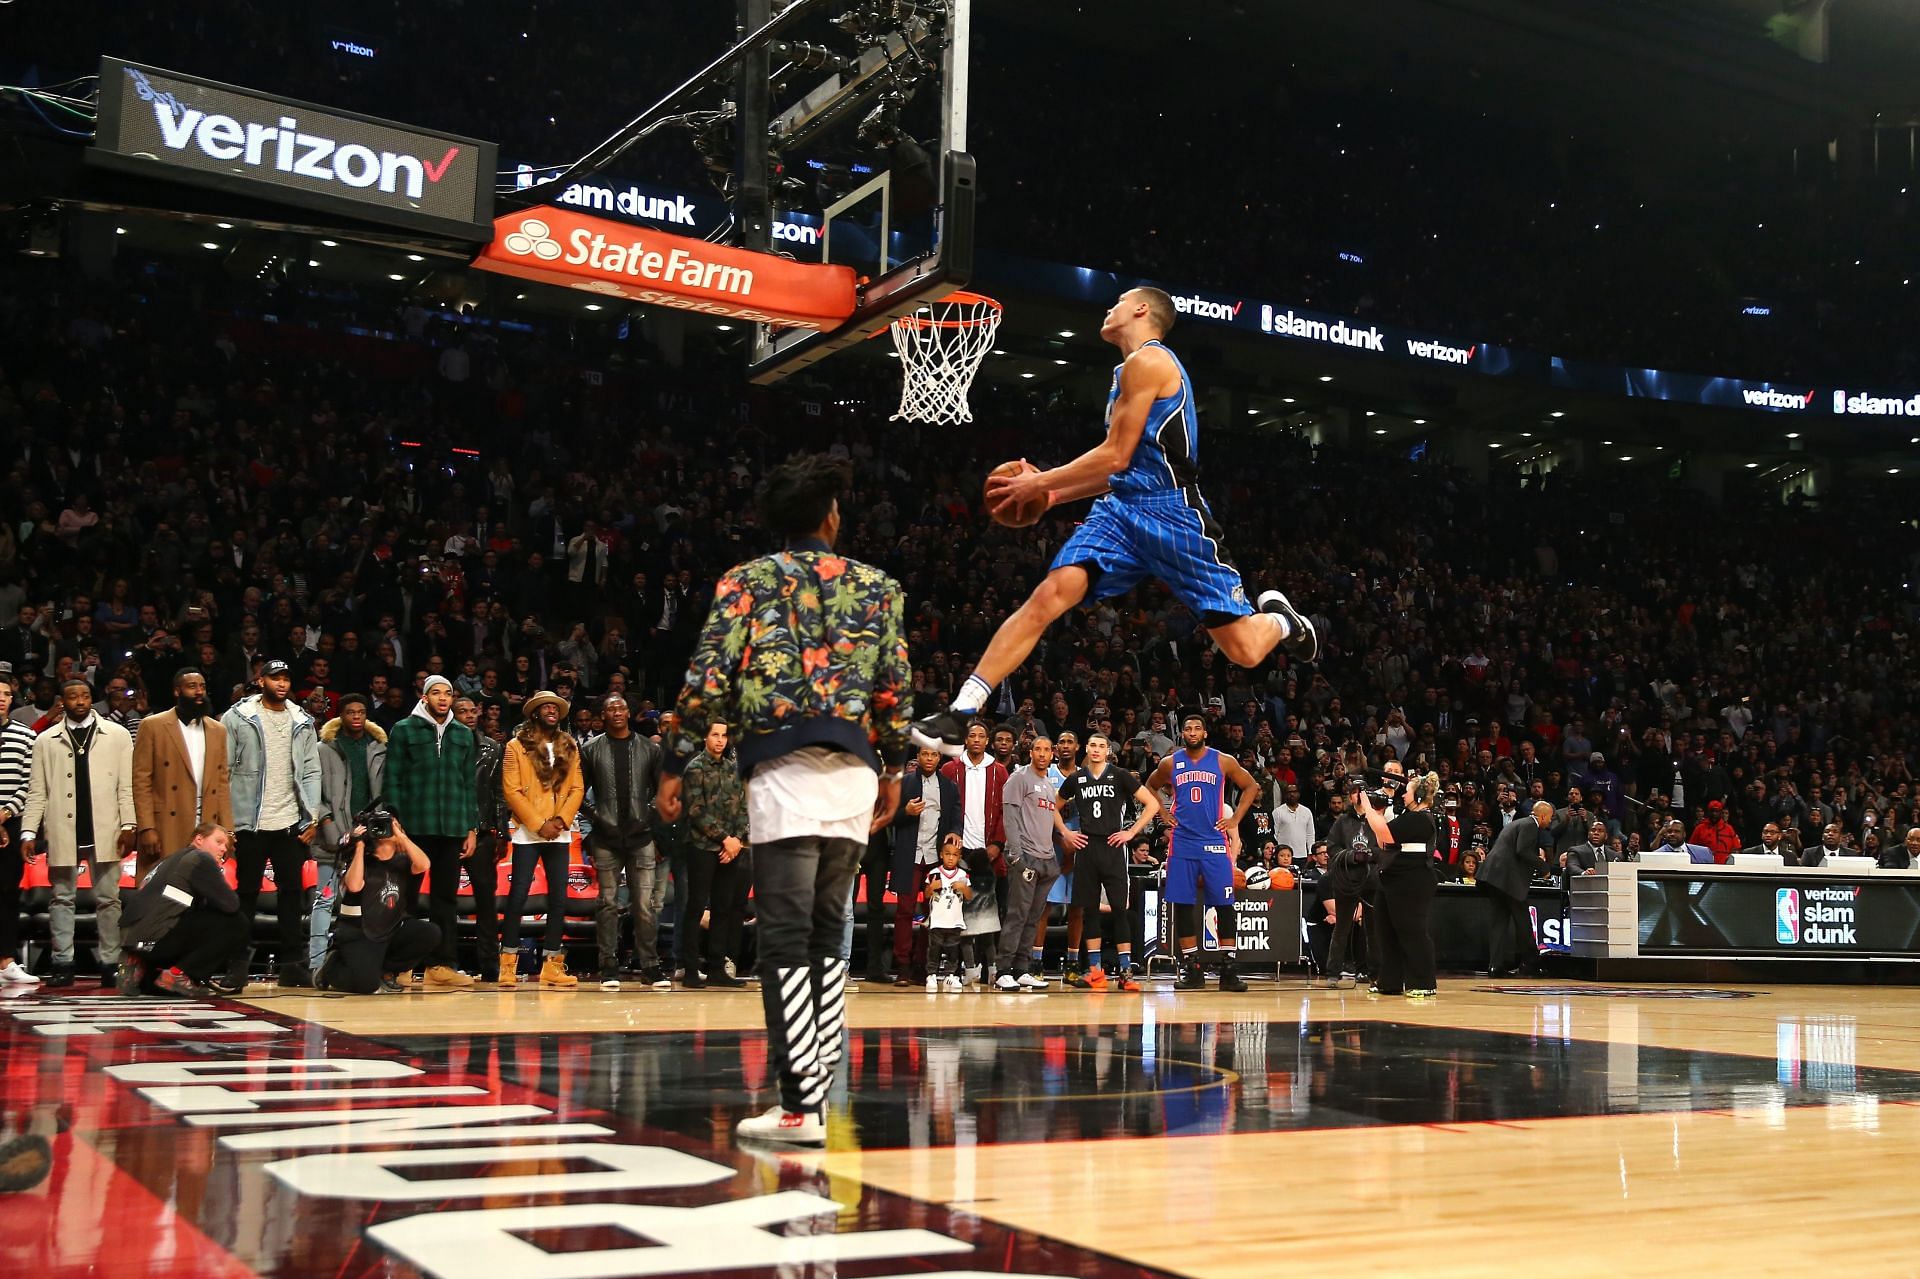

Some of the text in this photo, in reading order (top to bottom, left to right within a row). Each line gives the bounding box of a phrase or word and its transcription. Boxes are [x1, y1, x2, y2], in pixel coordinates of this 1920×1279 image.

[154, 102, 424, 199] verizon
[617, 187, 695, 226] dunk
[1274, 310, 1384, 352] slam dunk
[1407, 339, 1468, 365] verizon
[1743, 388, 1806, 409] verizon
[1847, 392, 1903, 416] slam
[1175, 770, 1217, 786] DETROIT
[1080, 785, 1115, 799] WOLVES
[1190, 786, 1202, 803] 0
[1092, 801, 1102, 818] 8
[1804, 887, 1854, 901] verizon
[1233, 899, 1269, 912] erizon
[1804, 902, 1854, 923] slam
[1236, 913, 1268, 931] lam
[1237, 931, 1270, 950] unk
[1804, 923, 1857, 944] dunk
[103, 1057, 975, 1279] RONTO
